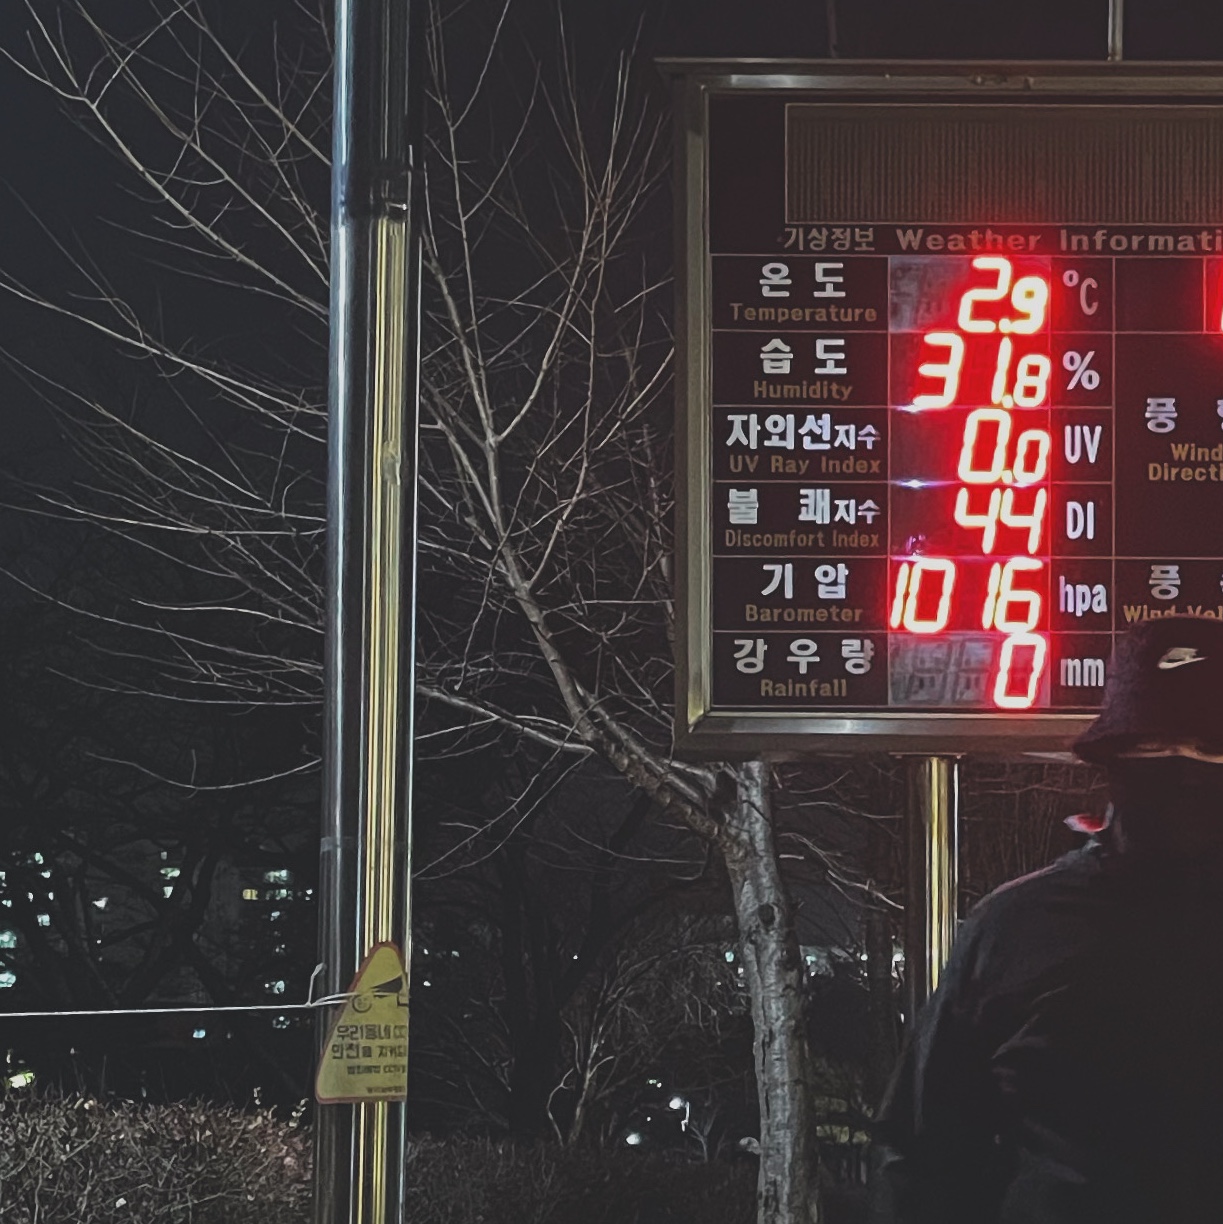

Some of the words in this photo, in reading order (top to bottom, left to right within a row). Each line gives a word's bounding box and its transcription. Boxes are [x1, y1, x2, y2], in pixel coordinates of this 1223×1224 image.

[784, 228, 876, 252] 기상정보
[896, 228, 1042, 252] Weather
[957, 256, 1049, 334] 2.9
[1062, 270, 1099, 316] °C
[730, 302, 878, 324] Temperature
[912, 332, 1051, 409] 31.8
[1062, 351, 1101, 391] %
[753, 379, 853, 402] Humidity
[957, 407, 1050, 484] 0.0
[1064, 424, 1102, 465] UV
[1170, 443, 1223, 462] Wind
[729, 455, 759, 474] UV
[770, 455, 809, 476] Ray
[821, 455, 881, 474] Index
[954, 487, 1048, 555] 44
[1066, 500, 1095, 541] DI
[725, 529, 825, 548] Discomfort
[832, 529, 880, 548] Index
[745, 604, 864, 623] Barometer
[1059, 575, 1108, 617] hpa
[1123, 604, 1177, 623] Wind
[993, 631, 1047, 709] 0
[1060, 657, 1105, 688] mm
[760, 678, 847, 698] Rainfall
